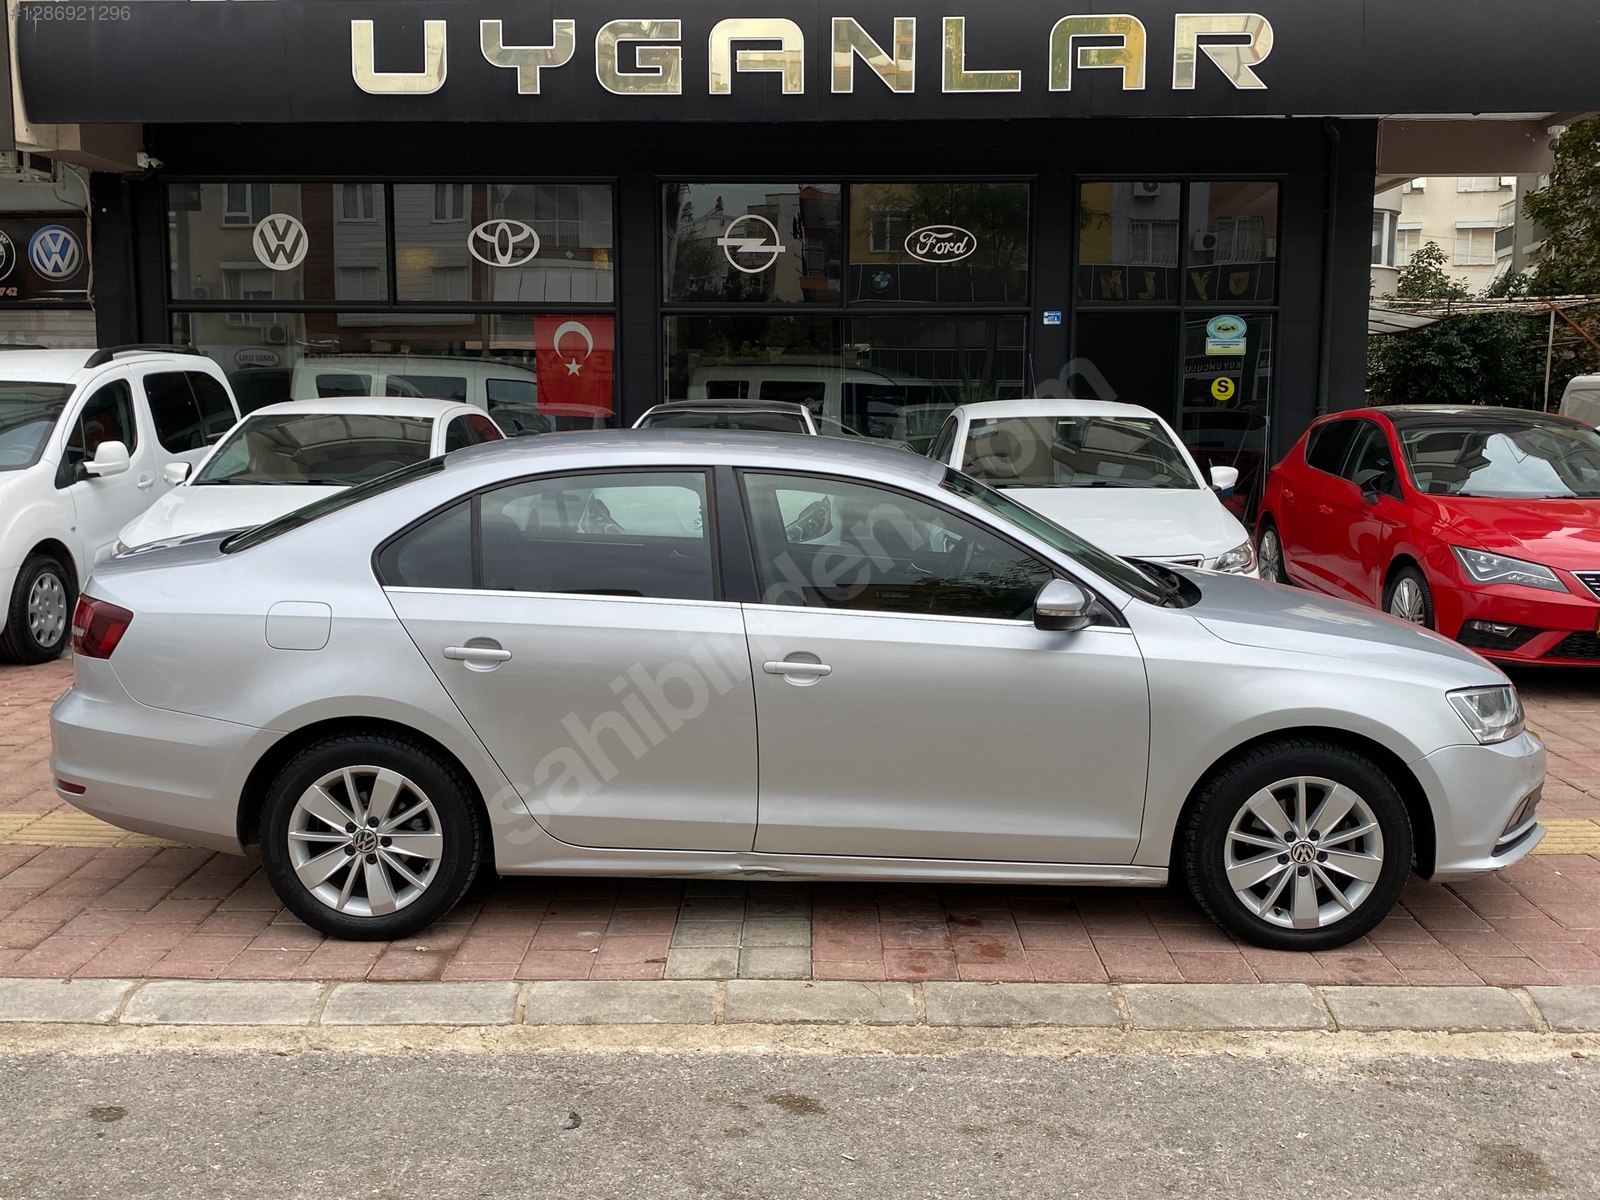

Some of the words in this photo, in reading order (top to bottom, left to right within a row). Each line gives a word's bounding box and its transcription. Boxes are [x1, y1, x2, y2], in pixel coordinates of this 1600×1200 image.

[350, 13, 1274, 96] UYGANLAR
[916, 230, 969, 255] Ford
[1217, 380, 1229, 394] S
